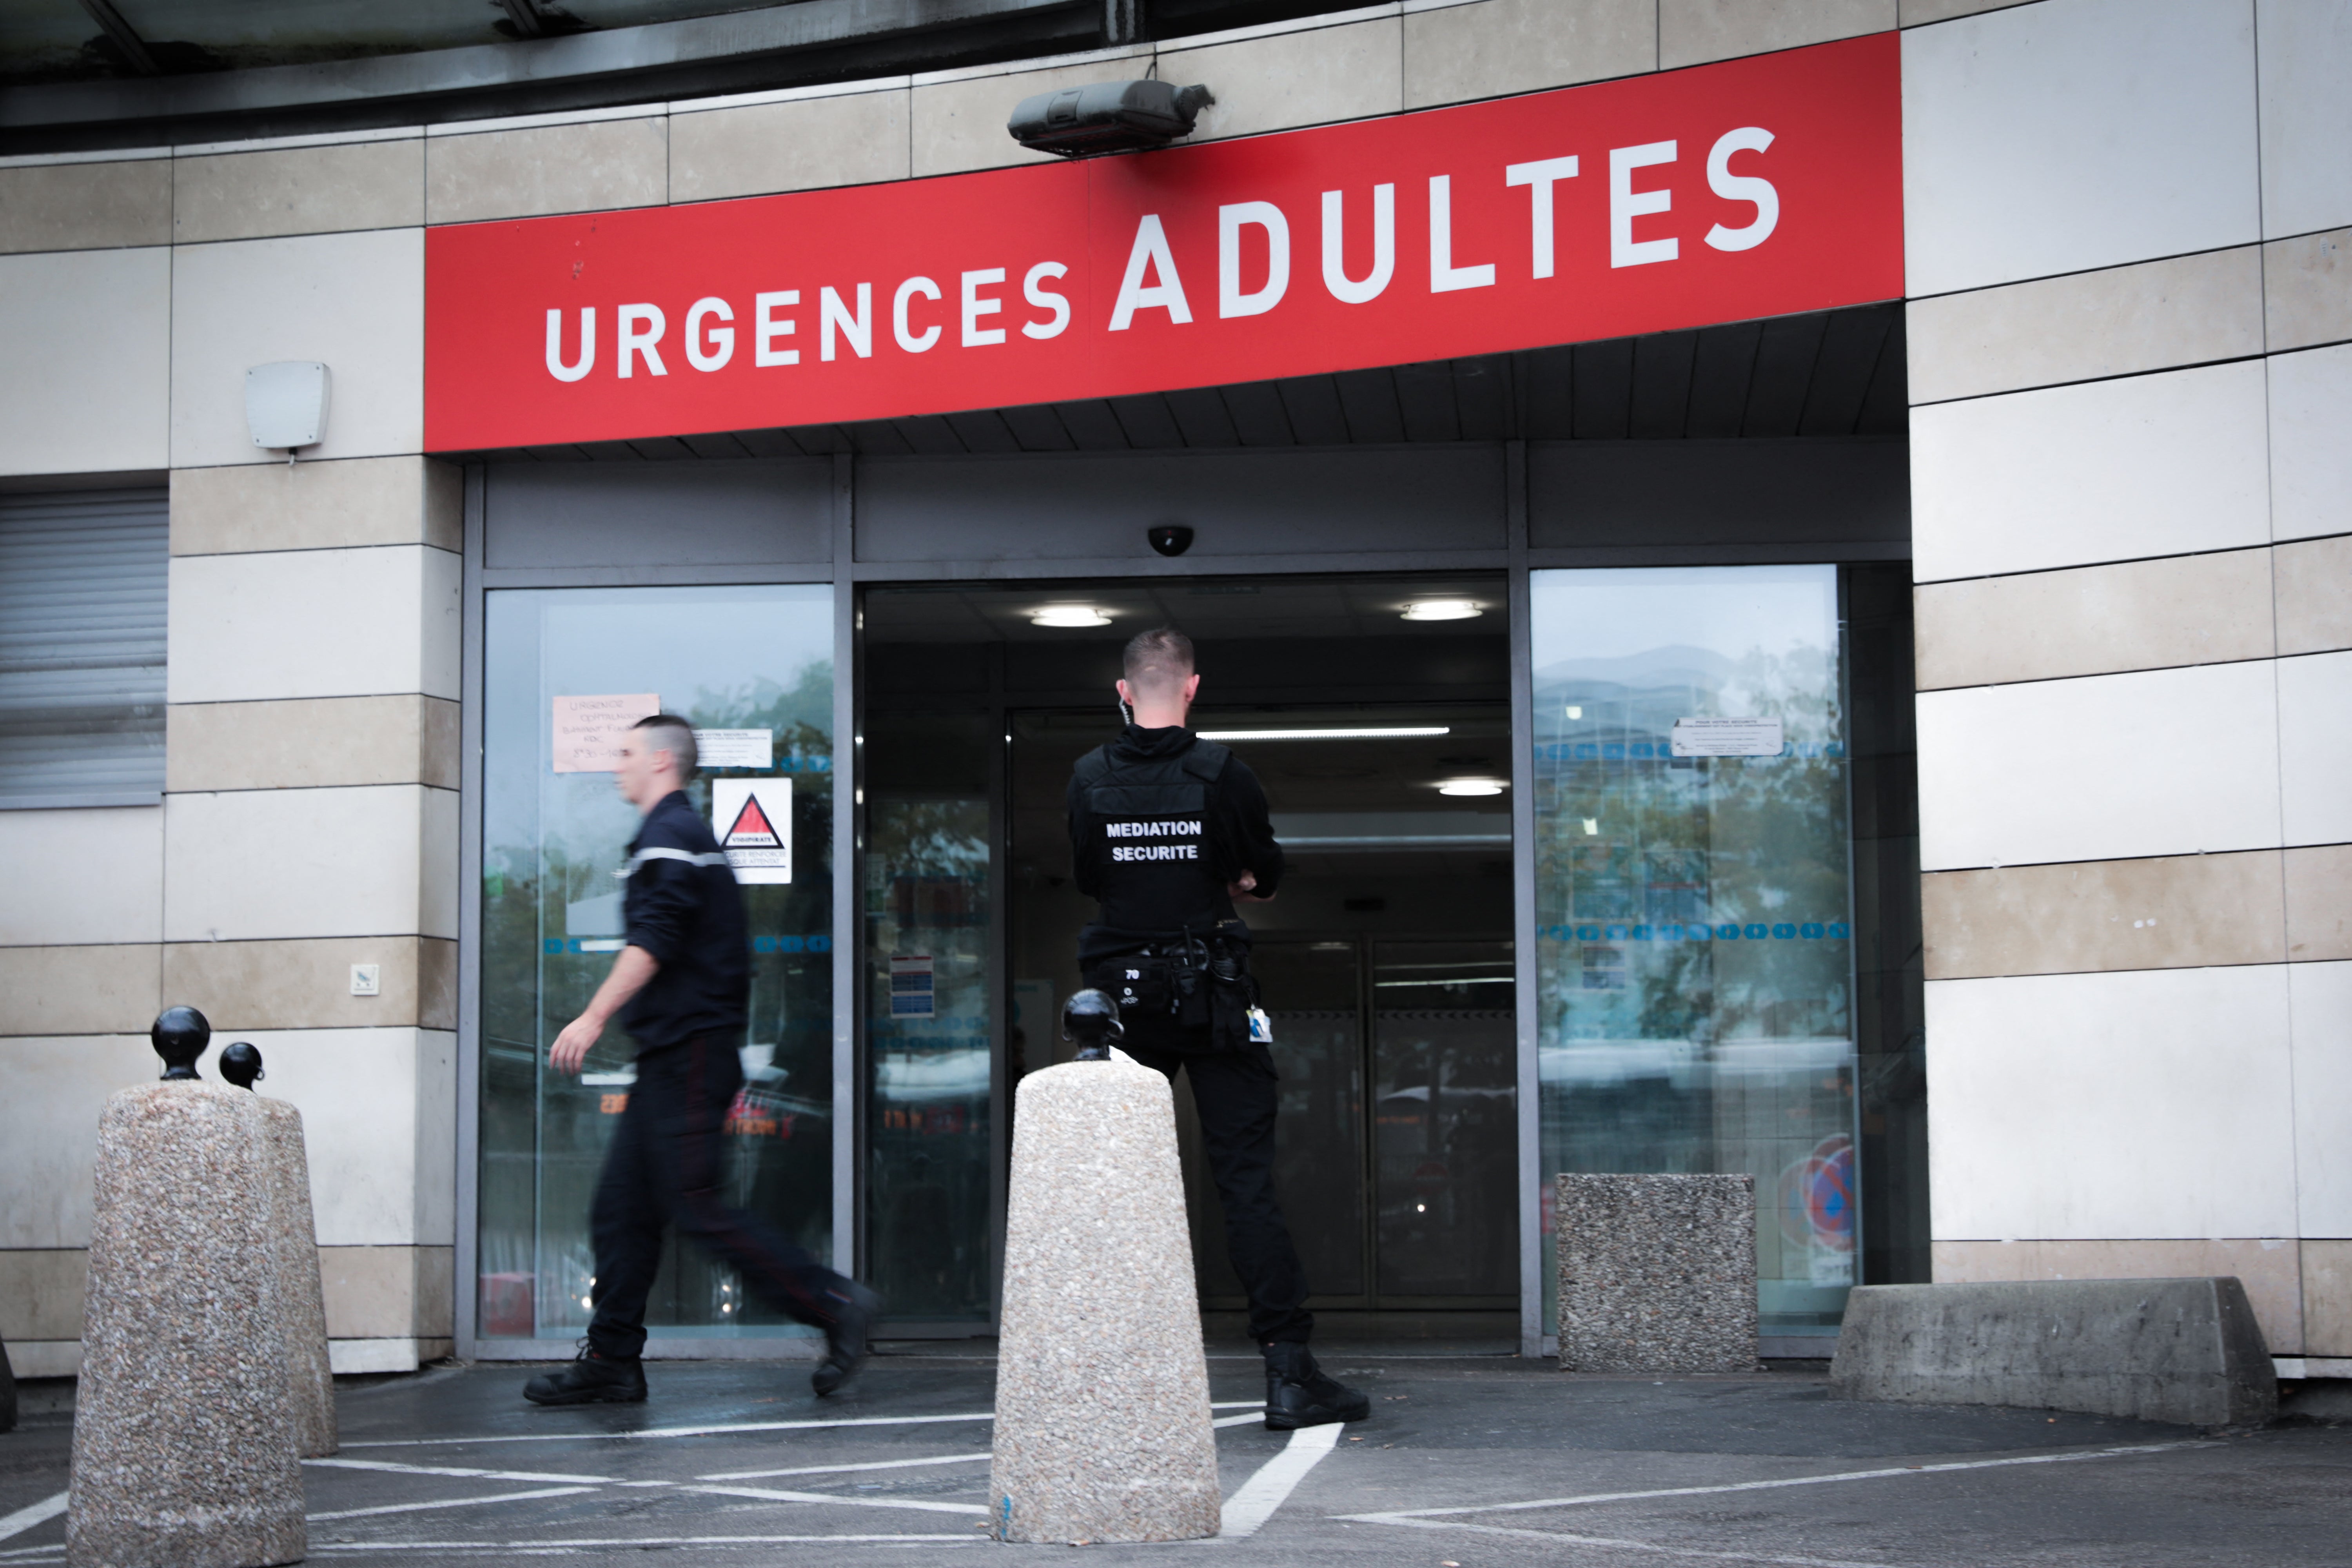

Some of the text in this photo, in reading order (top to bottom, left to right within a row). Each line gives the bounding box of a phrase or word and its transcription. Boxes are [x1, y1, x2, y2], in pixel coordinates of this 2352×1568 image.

[546, 127, 1780, 382] URGENCES ADULTES
[1107, 821, 1201, 838] MEDIATION
[1112, 845, 1198, 861] SECURITE
[1125, 969, 1140, 979] 70
